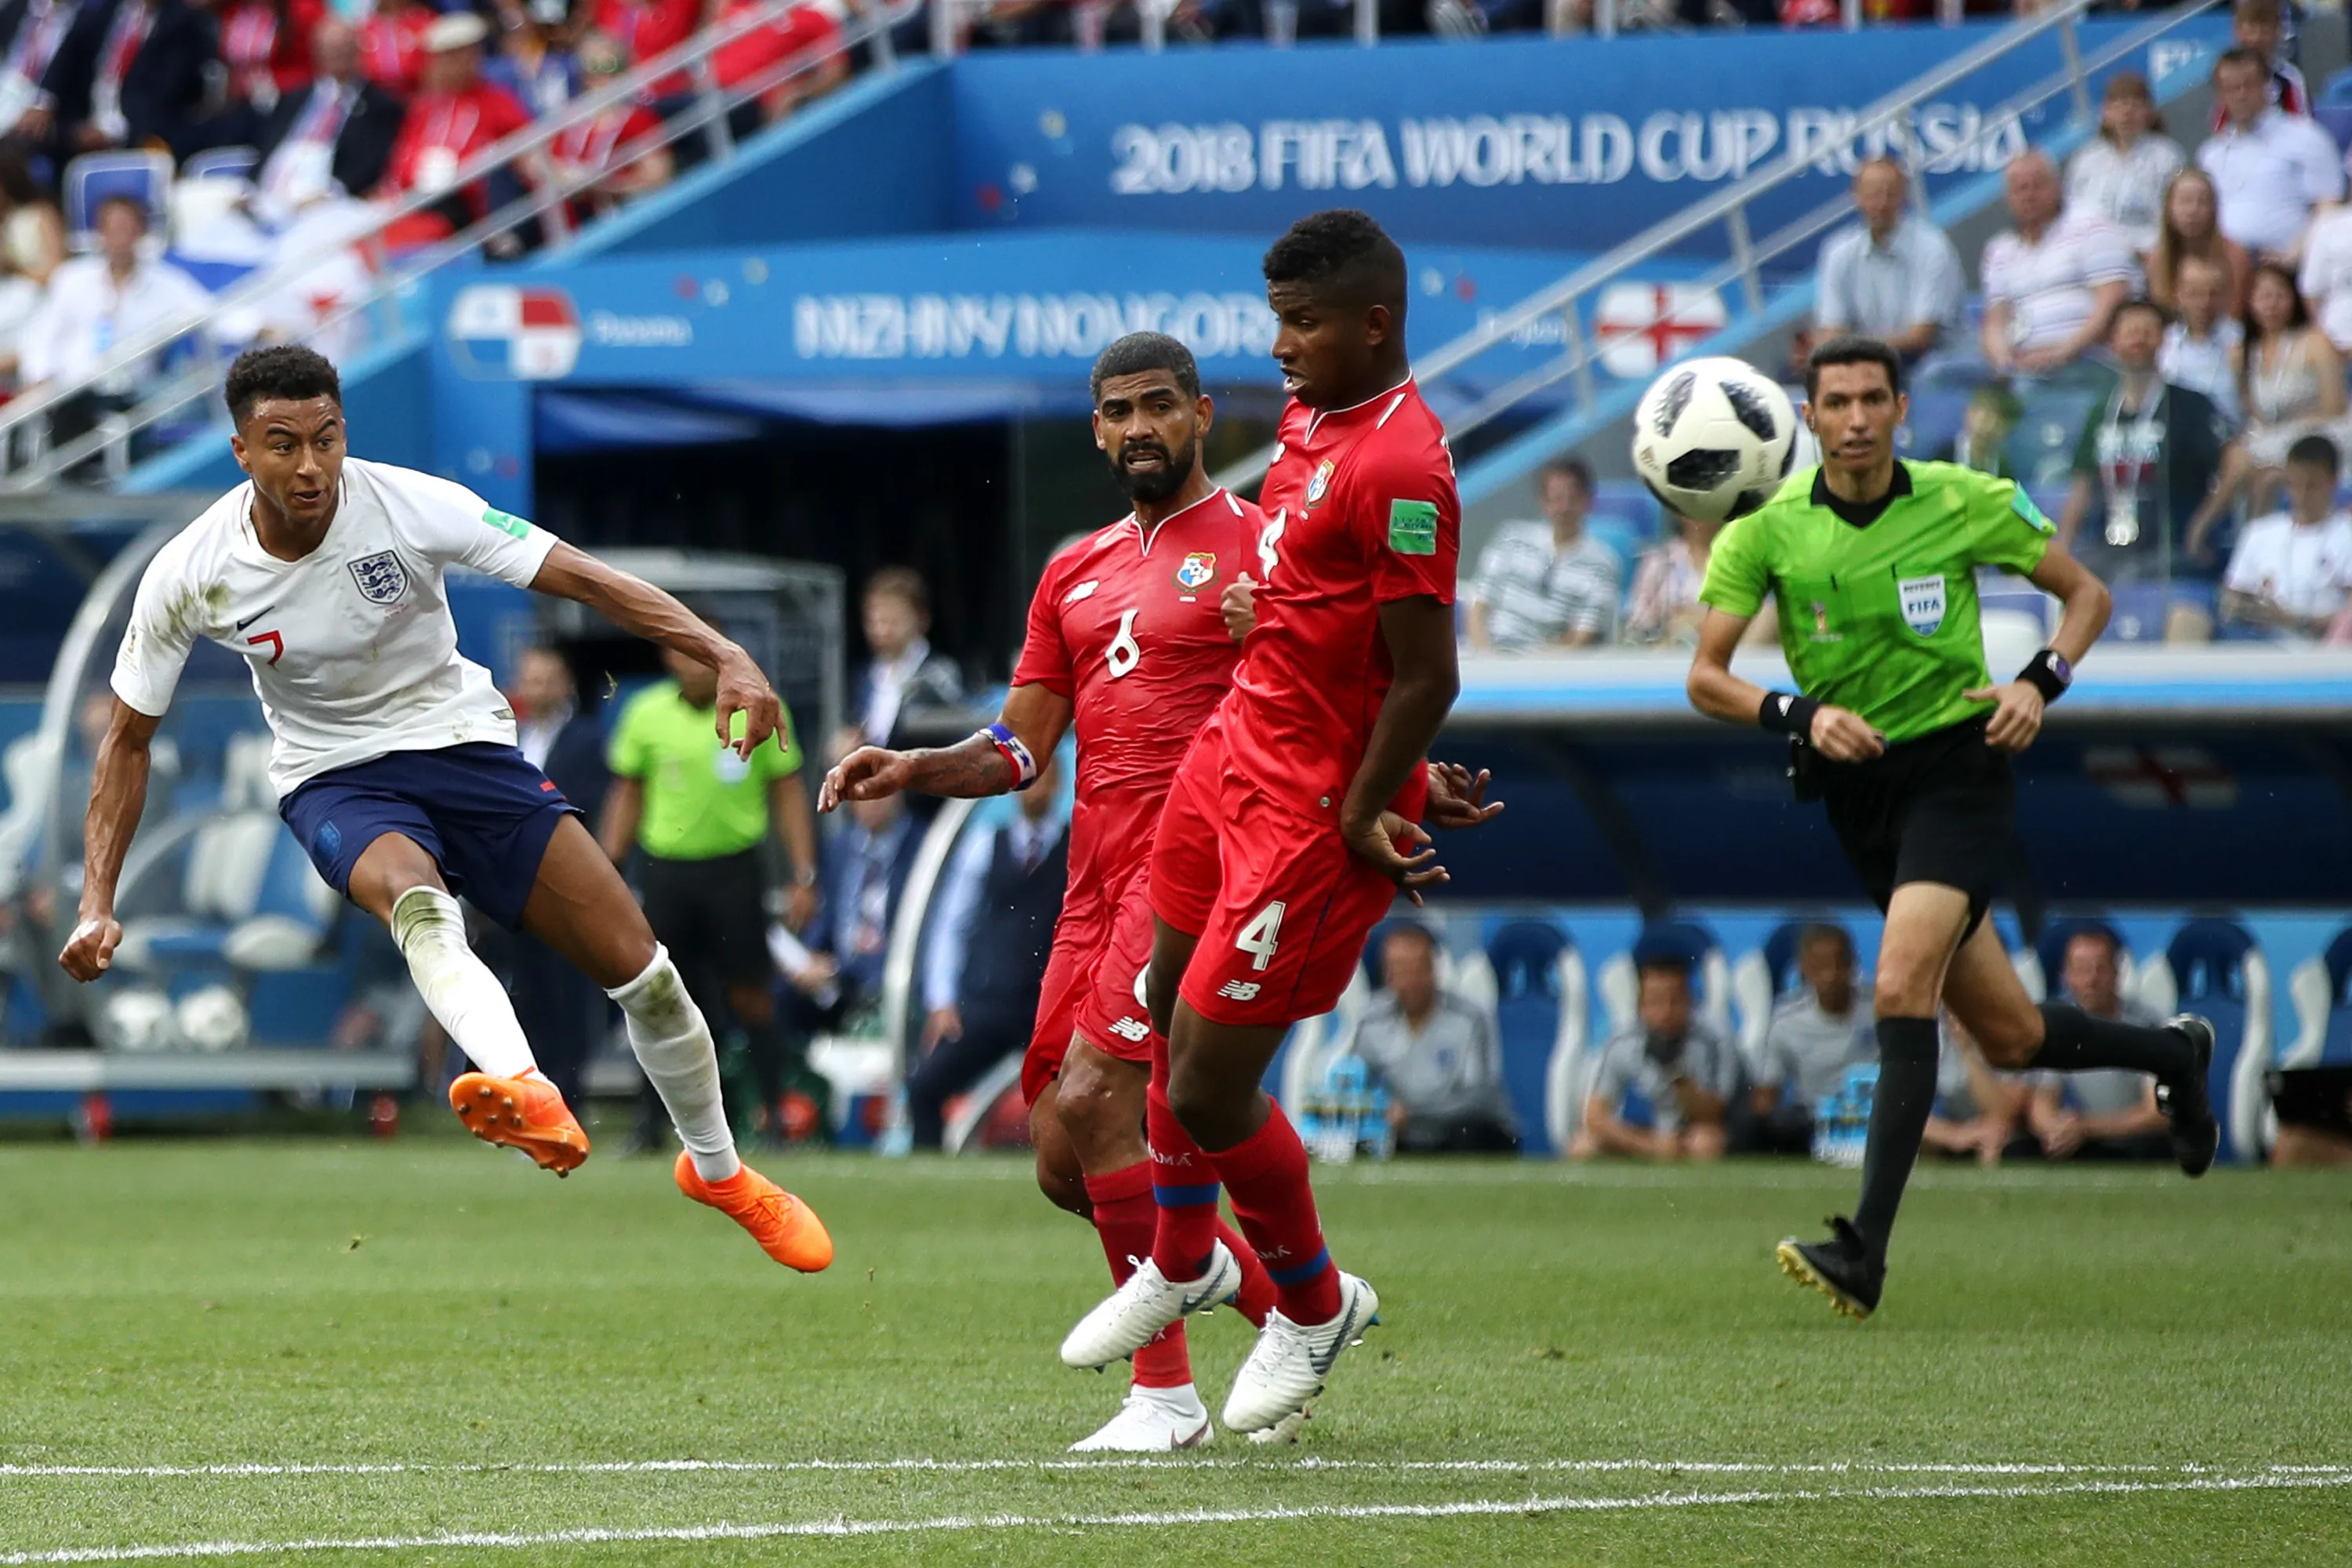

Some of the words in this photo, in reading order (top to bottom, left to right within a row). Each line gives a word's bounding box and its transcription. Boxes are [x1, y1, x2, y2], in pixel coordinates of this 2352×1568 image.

[1112, 122, 1256, 195] 2018
[1259, 118, 1397, 191] FIFA
[1400, 113, 1635, 187] WORLD
[1640, 108, 1778, 181] CUP
[793, 292, 1014, 358] NIZHNY
[1016, 292, 1280, 358] NOVGOR
[1907, 596, 1940, 615] FIFA
[246, 630, 285, 666] 7
[1105, 608, 1141, 678] 6
[1236, 899, 1287, 971] 4
